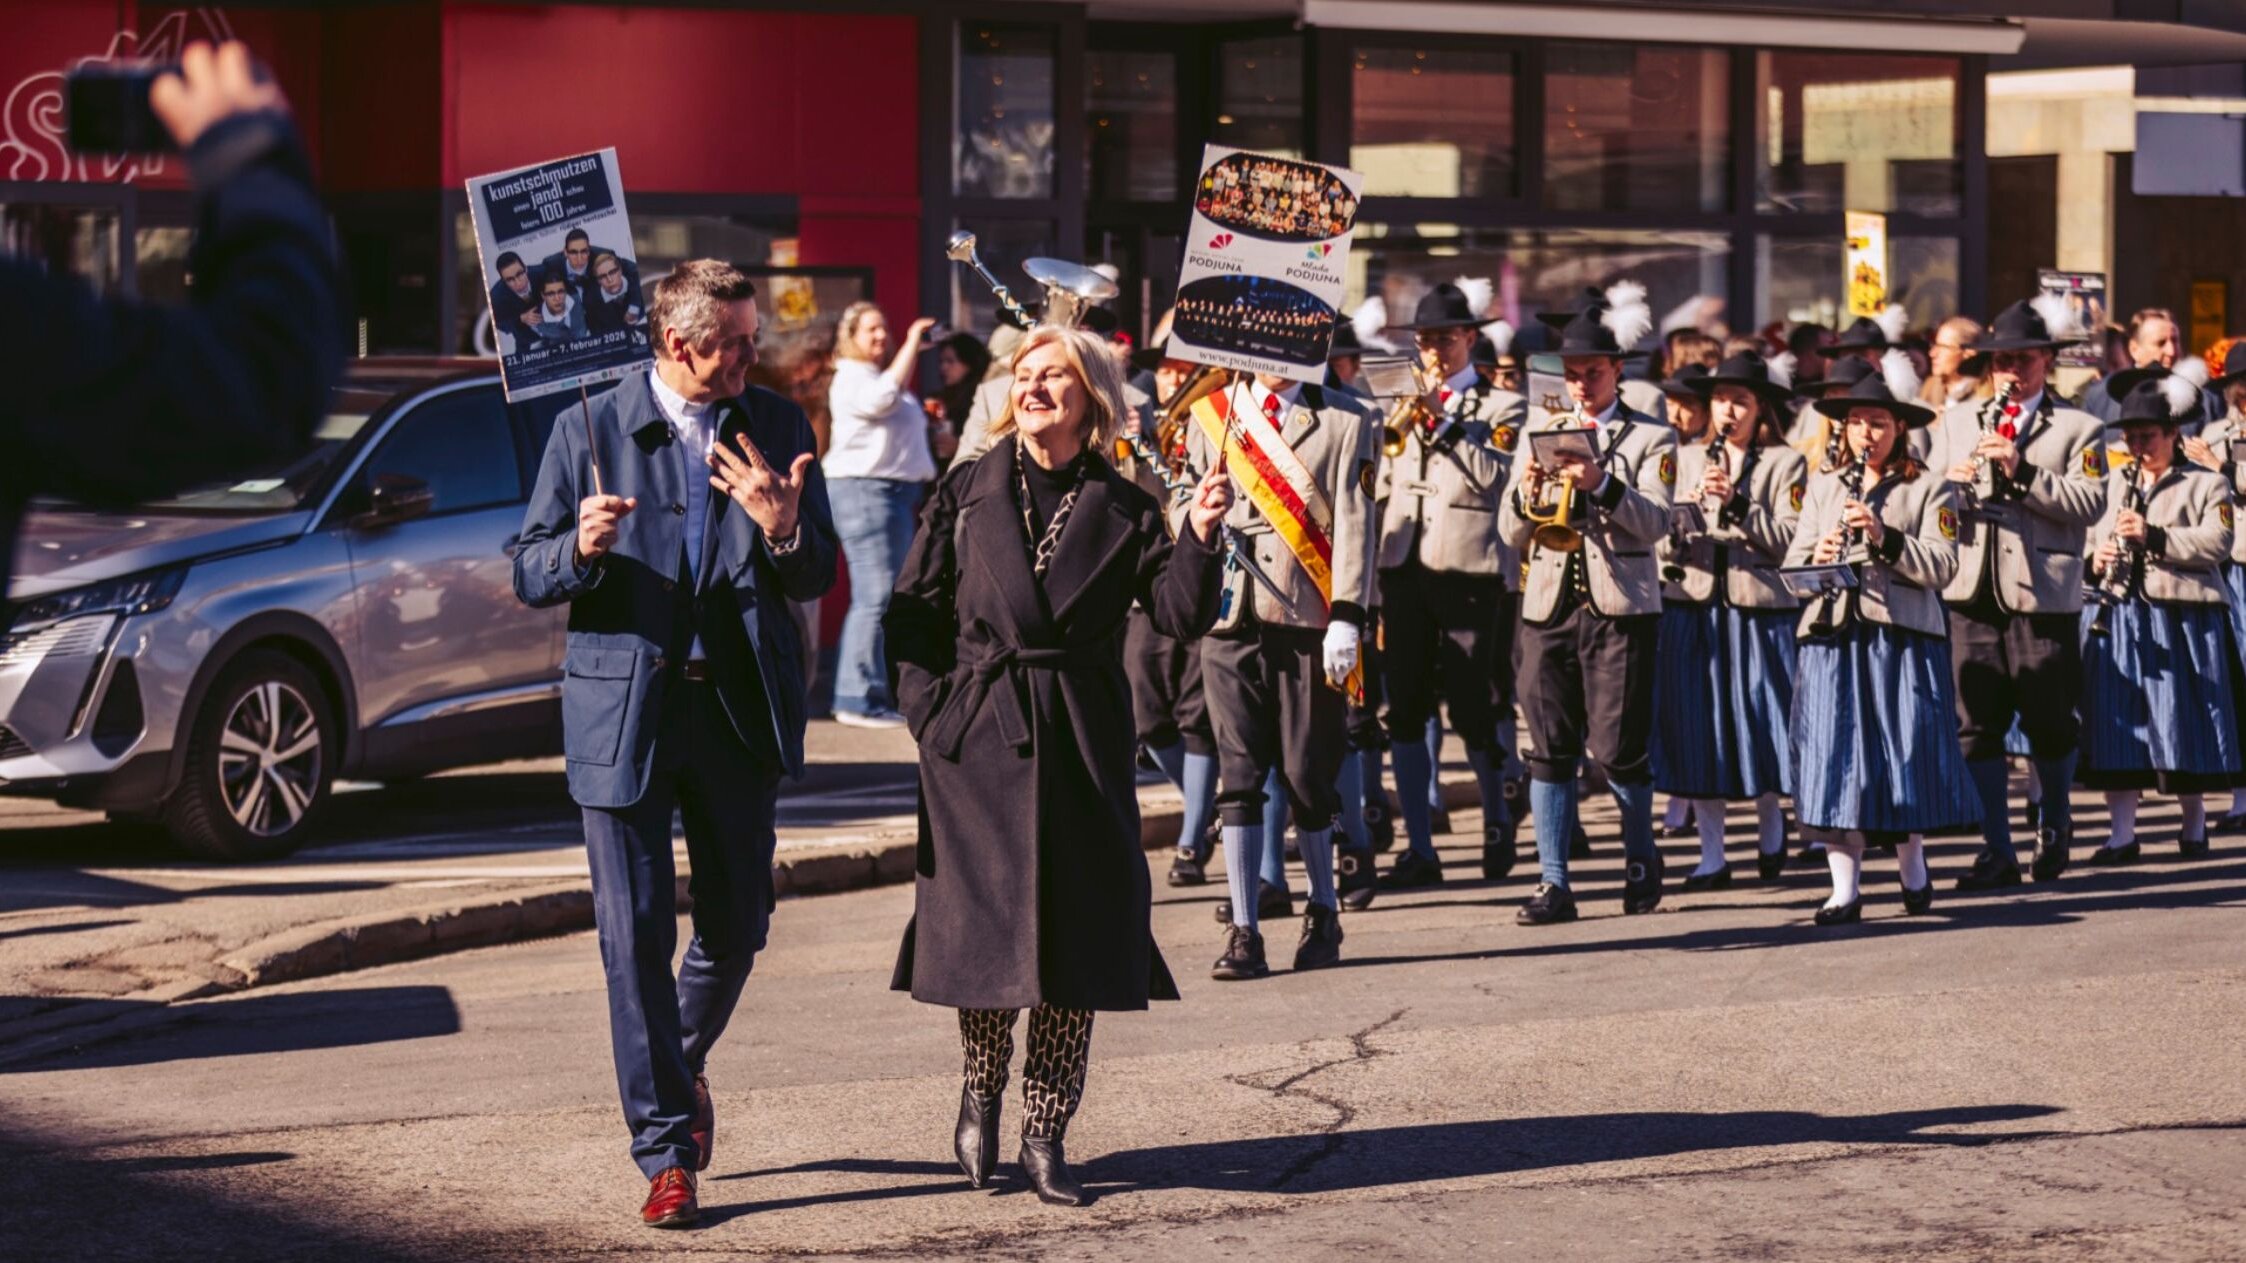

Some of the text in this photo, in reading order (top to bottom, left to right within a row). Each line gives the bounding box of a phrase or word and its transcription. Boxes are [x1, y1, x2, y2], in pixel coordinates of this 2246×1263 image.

[489, 158, 597, 202] kunstschmutzen
[531, 181, 563, 210] jandl
[540, 202, 565, 223] 100
[1189, 255, 1243, 273] PODJUNA
[1286, 267, 1341, 285] PODJUNA
[506, 355, 521, 367] 21.
[522, 350, 550, 365] januar
[559, 343, 569, 354] 7.
[570, 337, 602, 352] februar
[604, 330, 626, 344] 2026
[1199, 350, 1288, 375] www.podjuna.at
